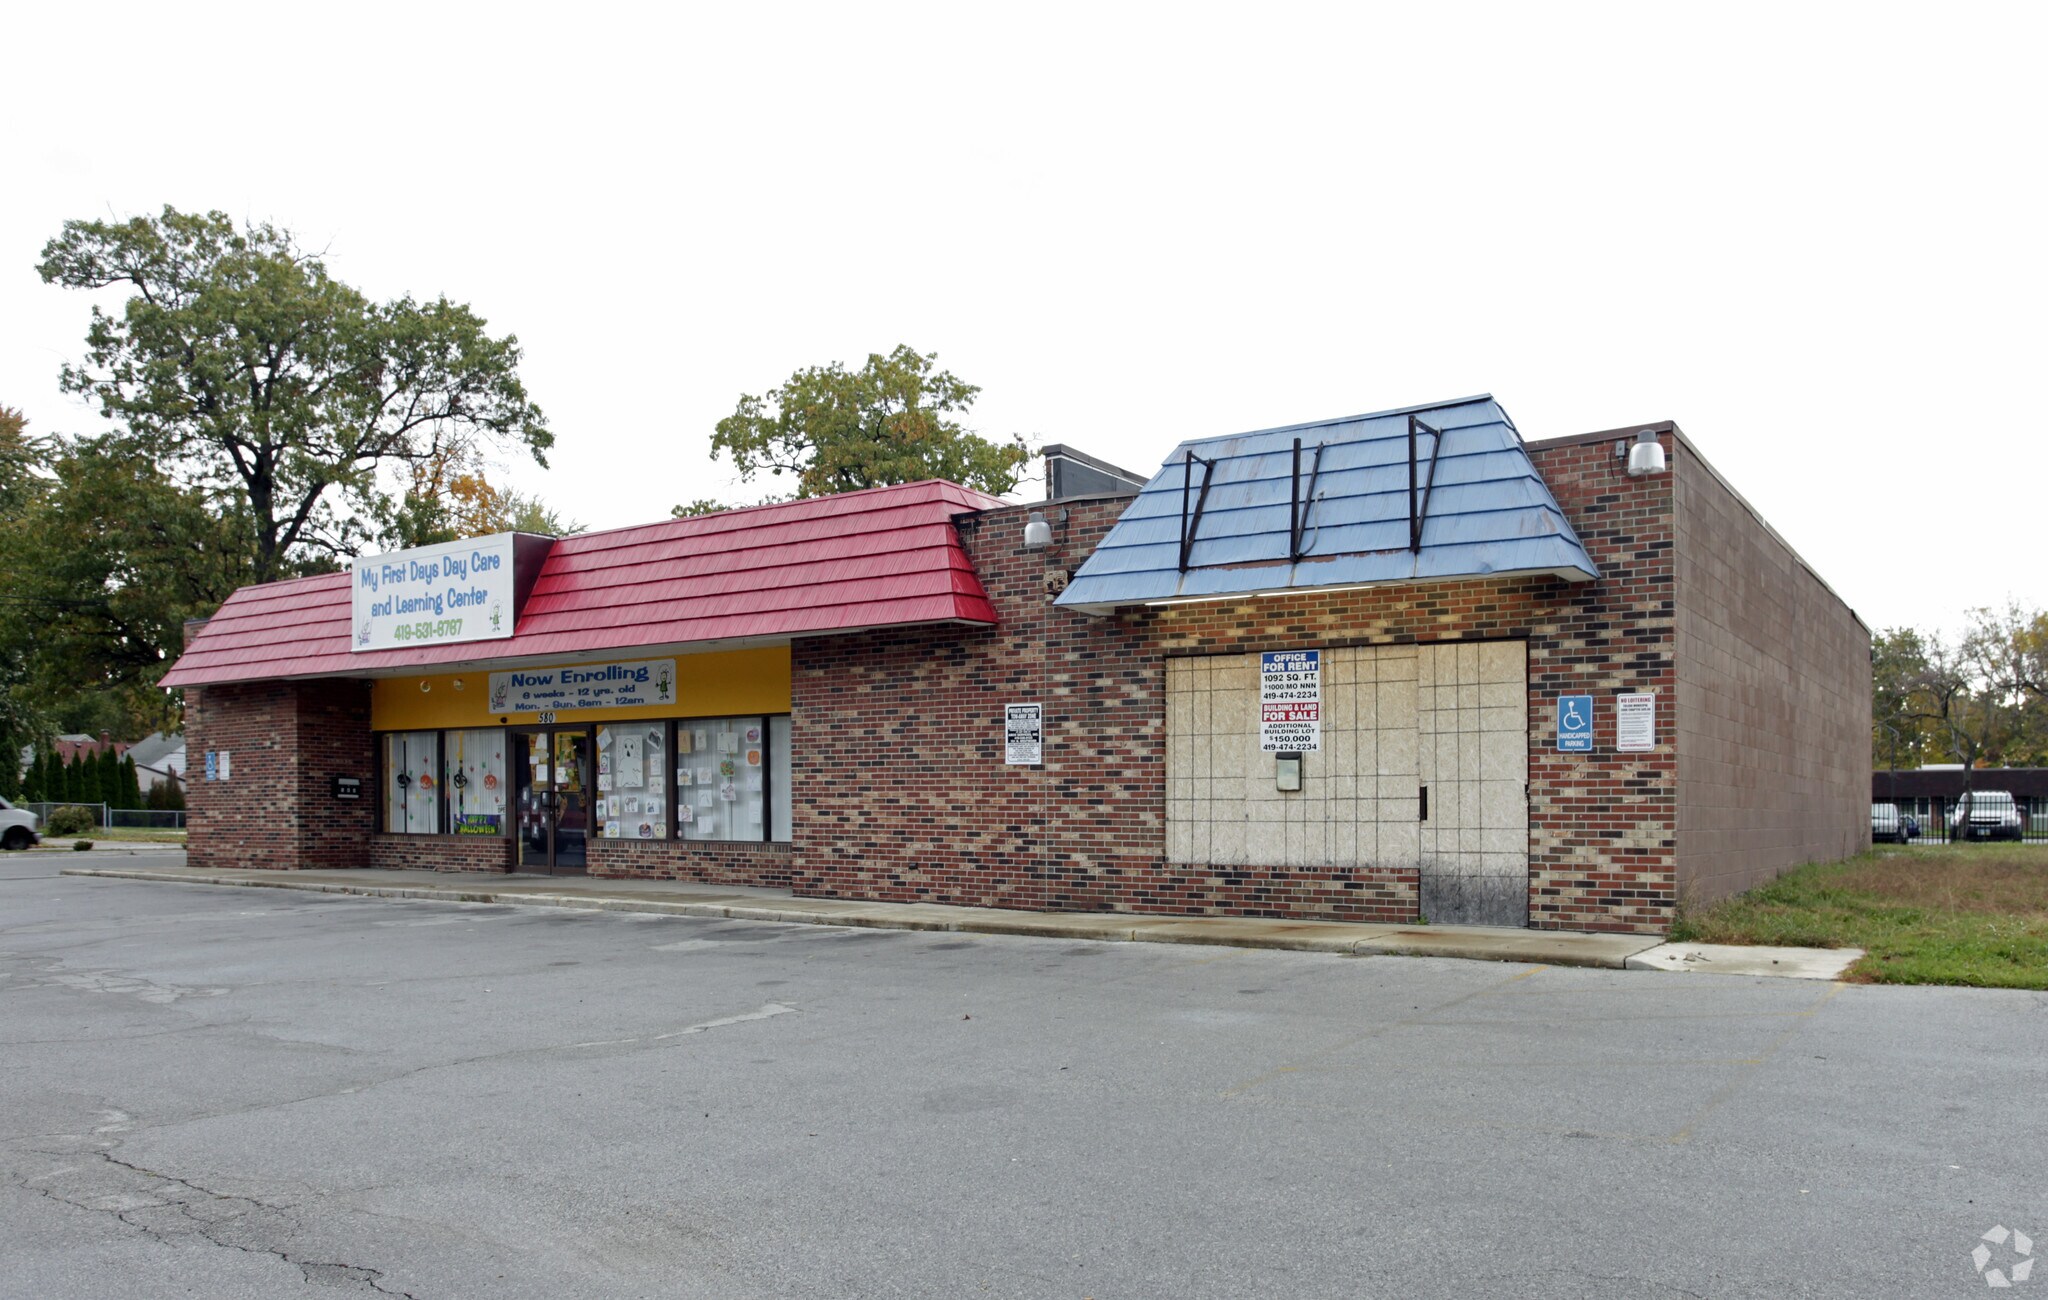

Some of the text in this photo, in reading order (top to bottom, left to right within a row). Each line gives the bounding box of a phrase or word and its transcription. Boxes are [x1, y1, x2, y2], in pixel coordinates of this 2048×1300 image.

[361, 551, 500, 592] My First Days Day Care
[371, 586, 488, 617] and Learning Center
[1273, 653, 1307, 662] OFFICE
[1263, 661, 1317, 672] FOR RENT
[511, 665, 649, 688] Now Enrolling
[1264, 674, 1284, 682] 1092
[534, 691, 565, 699] weeks
[578, 688, 590, 696] 12
[594, 689, 614, 698] yrs.
[618, 685, 635, 693] old
[1263, 691, 1317, 699] 419-474-2234
[515, 703, 540, 711] Mon.
[552, 701, 576, 710] Sun.
[615, 697, 644, 705] 12am
[1263, 704, 1292, 712] BUILDING
[1300, 703, 1317, 711] LAND
[538, 712, 553, 723] 580
[1263, 711, 1317, 721] FOR SALE
[1559, 732, 1590, 740] HANDICAPPED
[1263, 743, 1317, 751] 419-474-2234
